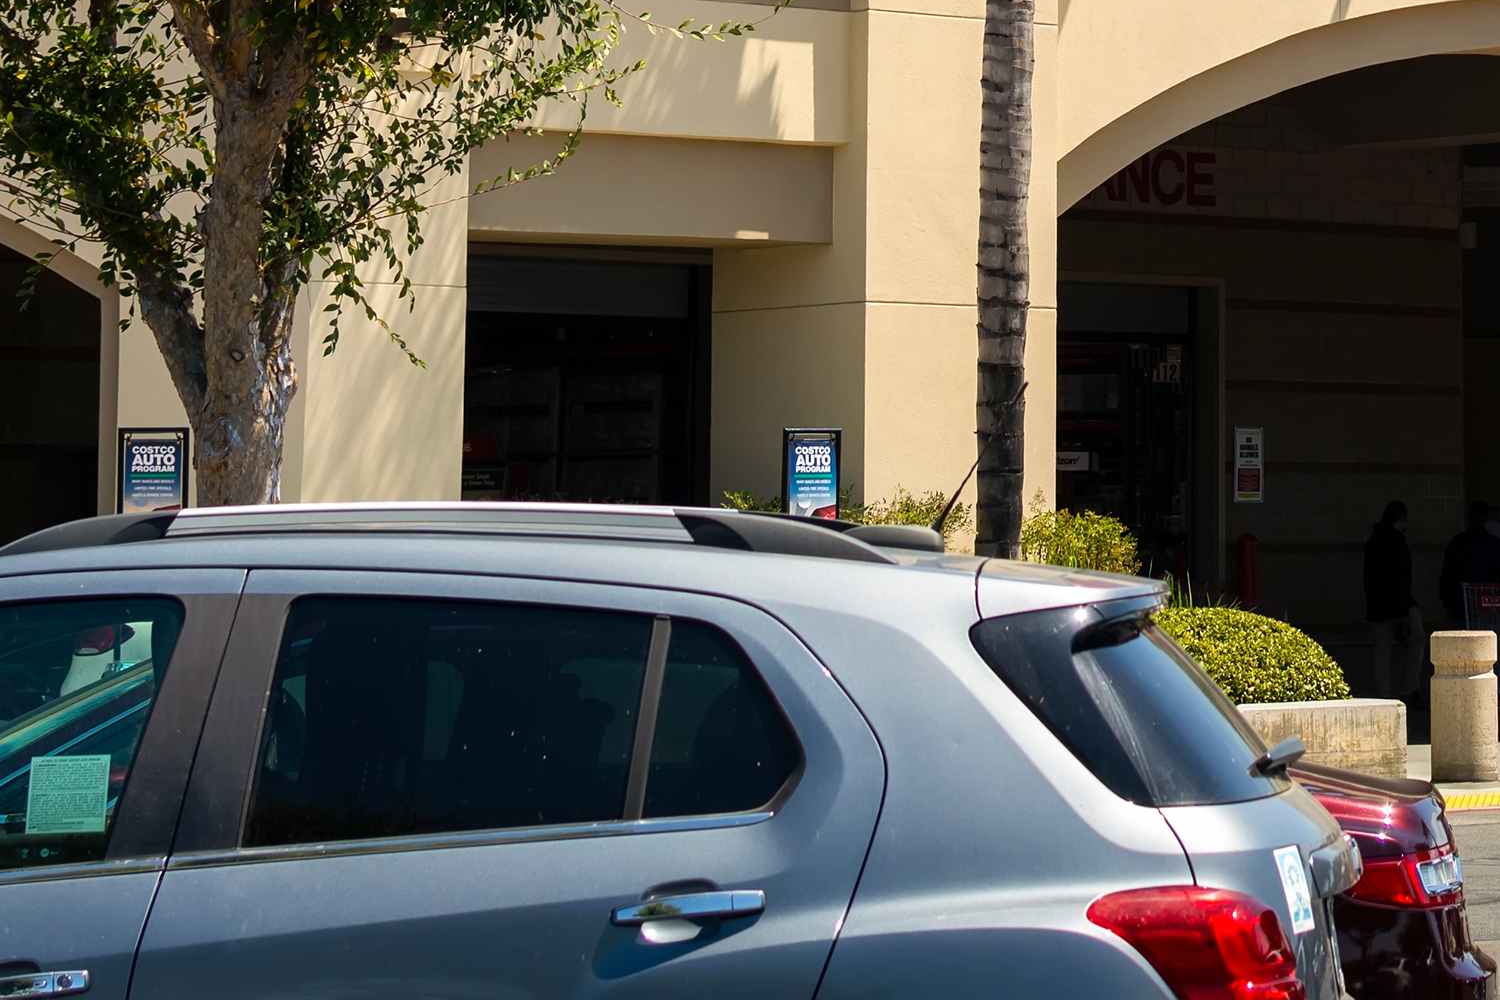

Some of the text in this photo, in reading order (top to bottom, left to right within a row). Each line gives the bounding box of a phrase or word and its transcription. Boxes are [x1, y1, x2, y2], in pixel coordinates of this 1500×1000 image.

[132, 446, 176, 454] COSTCO
[795, 446, 831, 454] COSTCO
[131, 454, 176, 466] AUTO
[795, 454, 831, 466] AUTO
